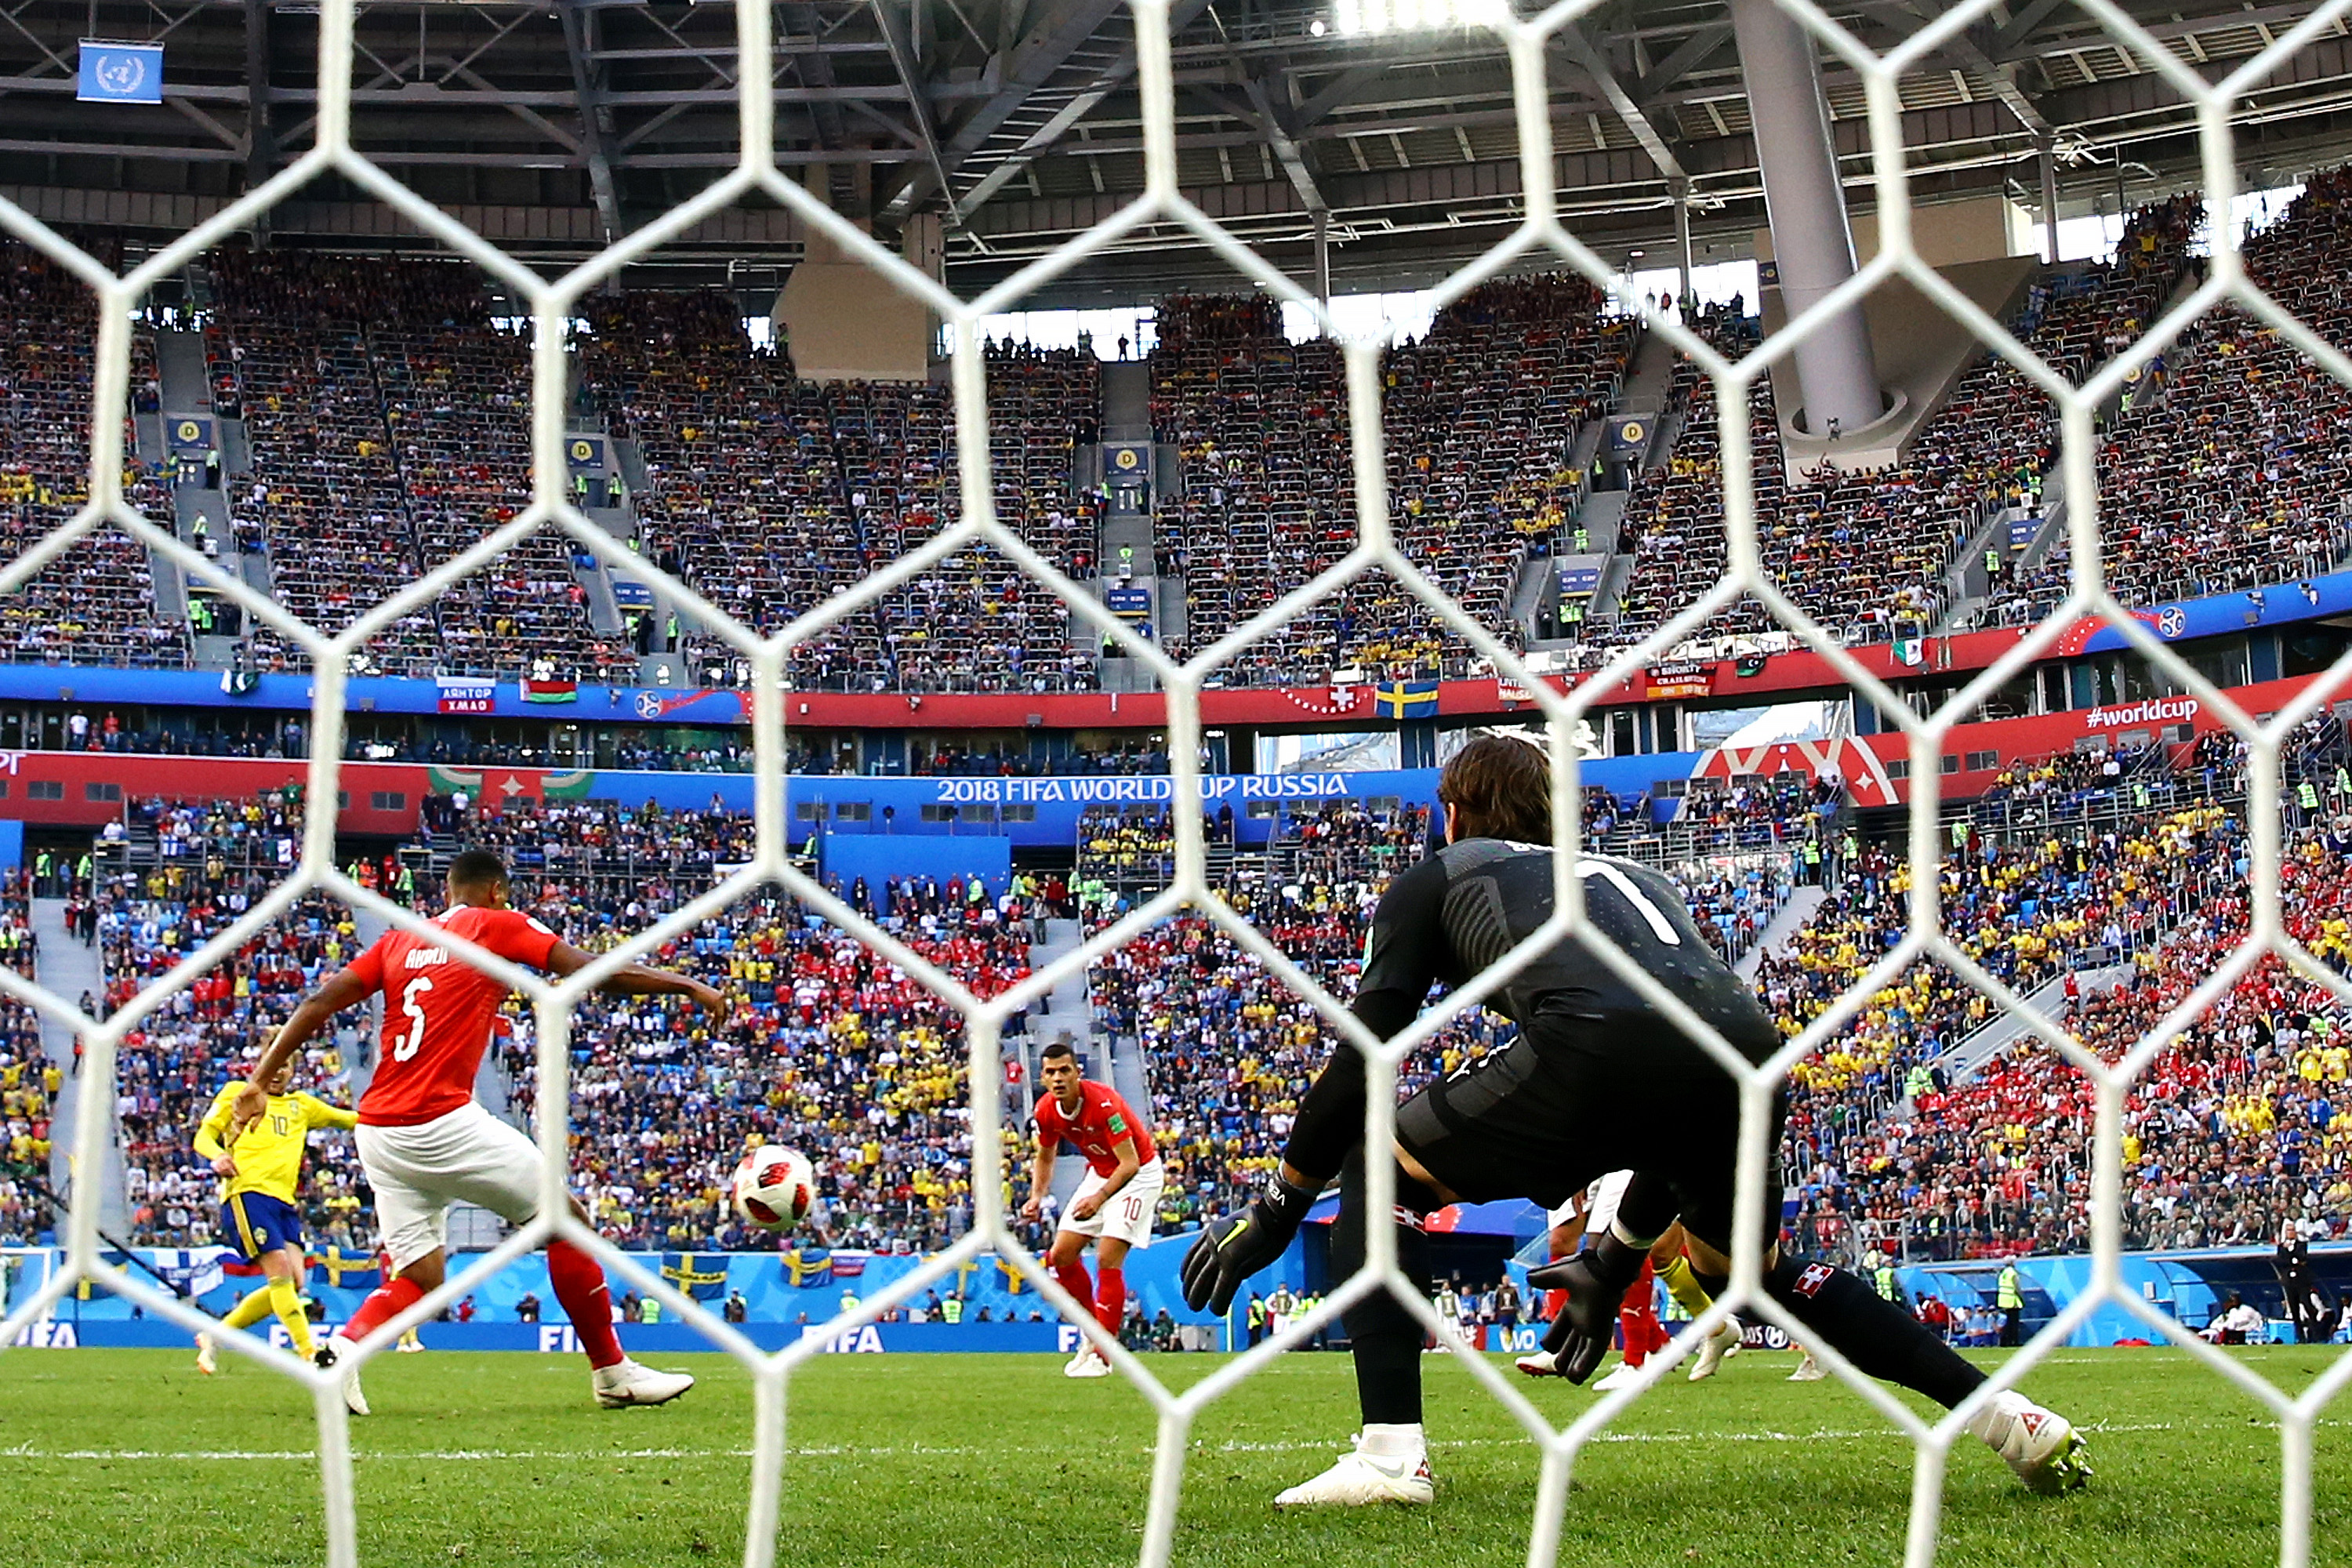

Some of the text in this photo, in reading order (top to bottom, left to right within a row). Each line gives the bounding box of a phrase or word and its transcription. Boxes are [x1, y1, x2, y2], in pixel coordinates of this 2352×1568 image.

[1628, 426, 1638, 437] D
[578, 445, 587, 456] D
[2086, 699, 2198, 728] #worldcup
[937, 774, 1348, 801] 2018 FIFA WORLD UP RUSSIA
[394, 976, 433, 1062] 5
[269, 1114, 288, 1137] 10
[1122, 1196, 1142, 1221] 10
[9, 1322, 78, 1348] IFA
